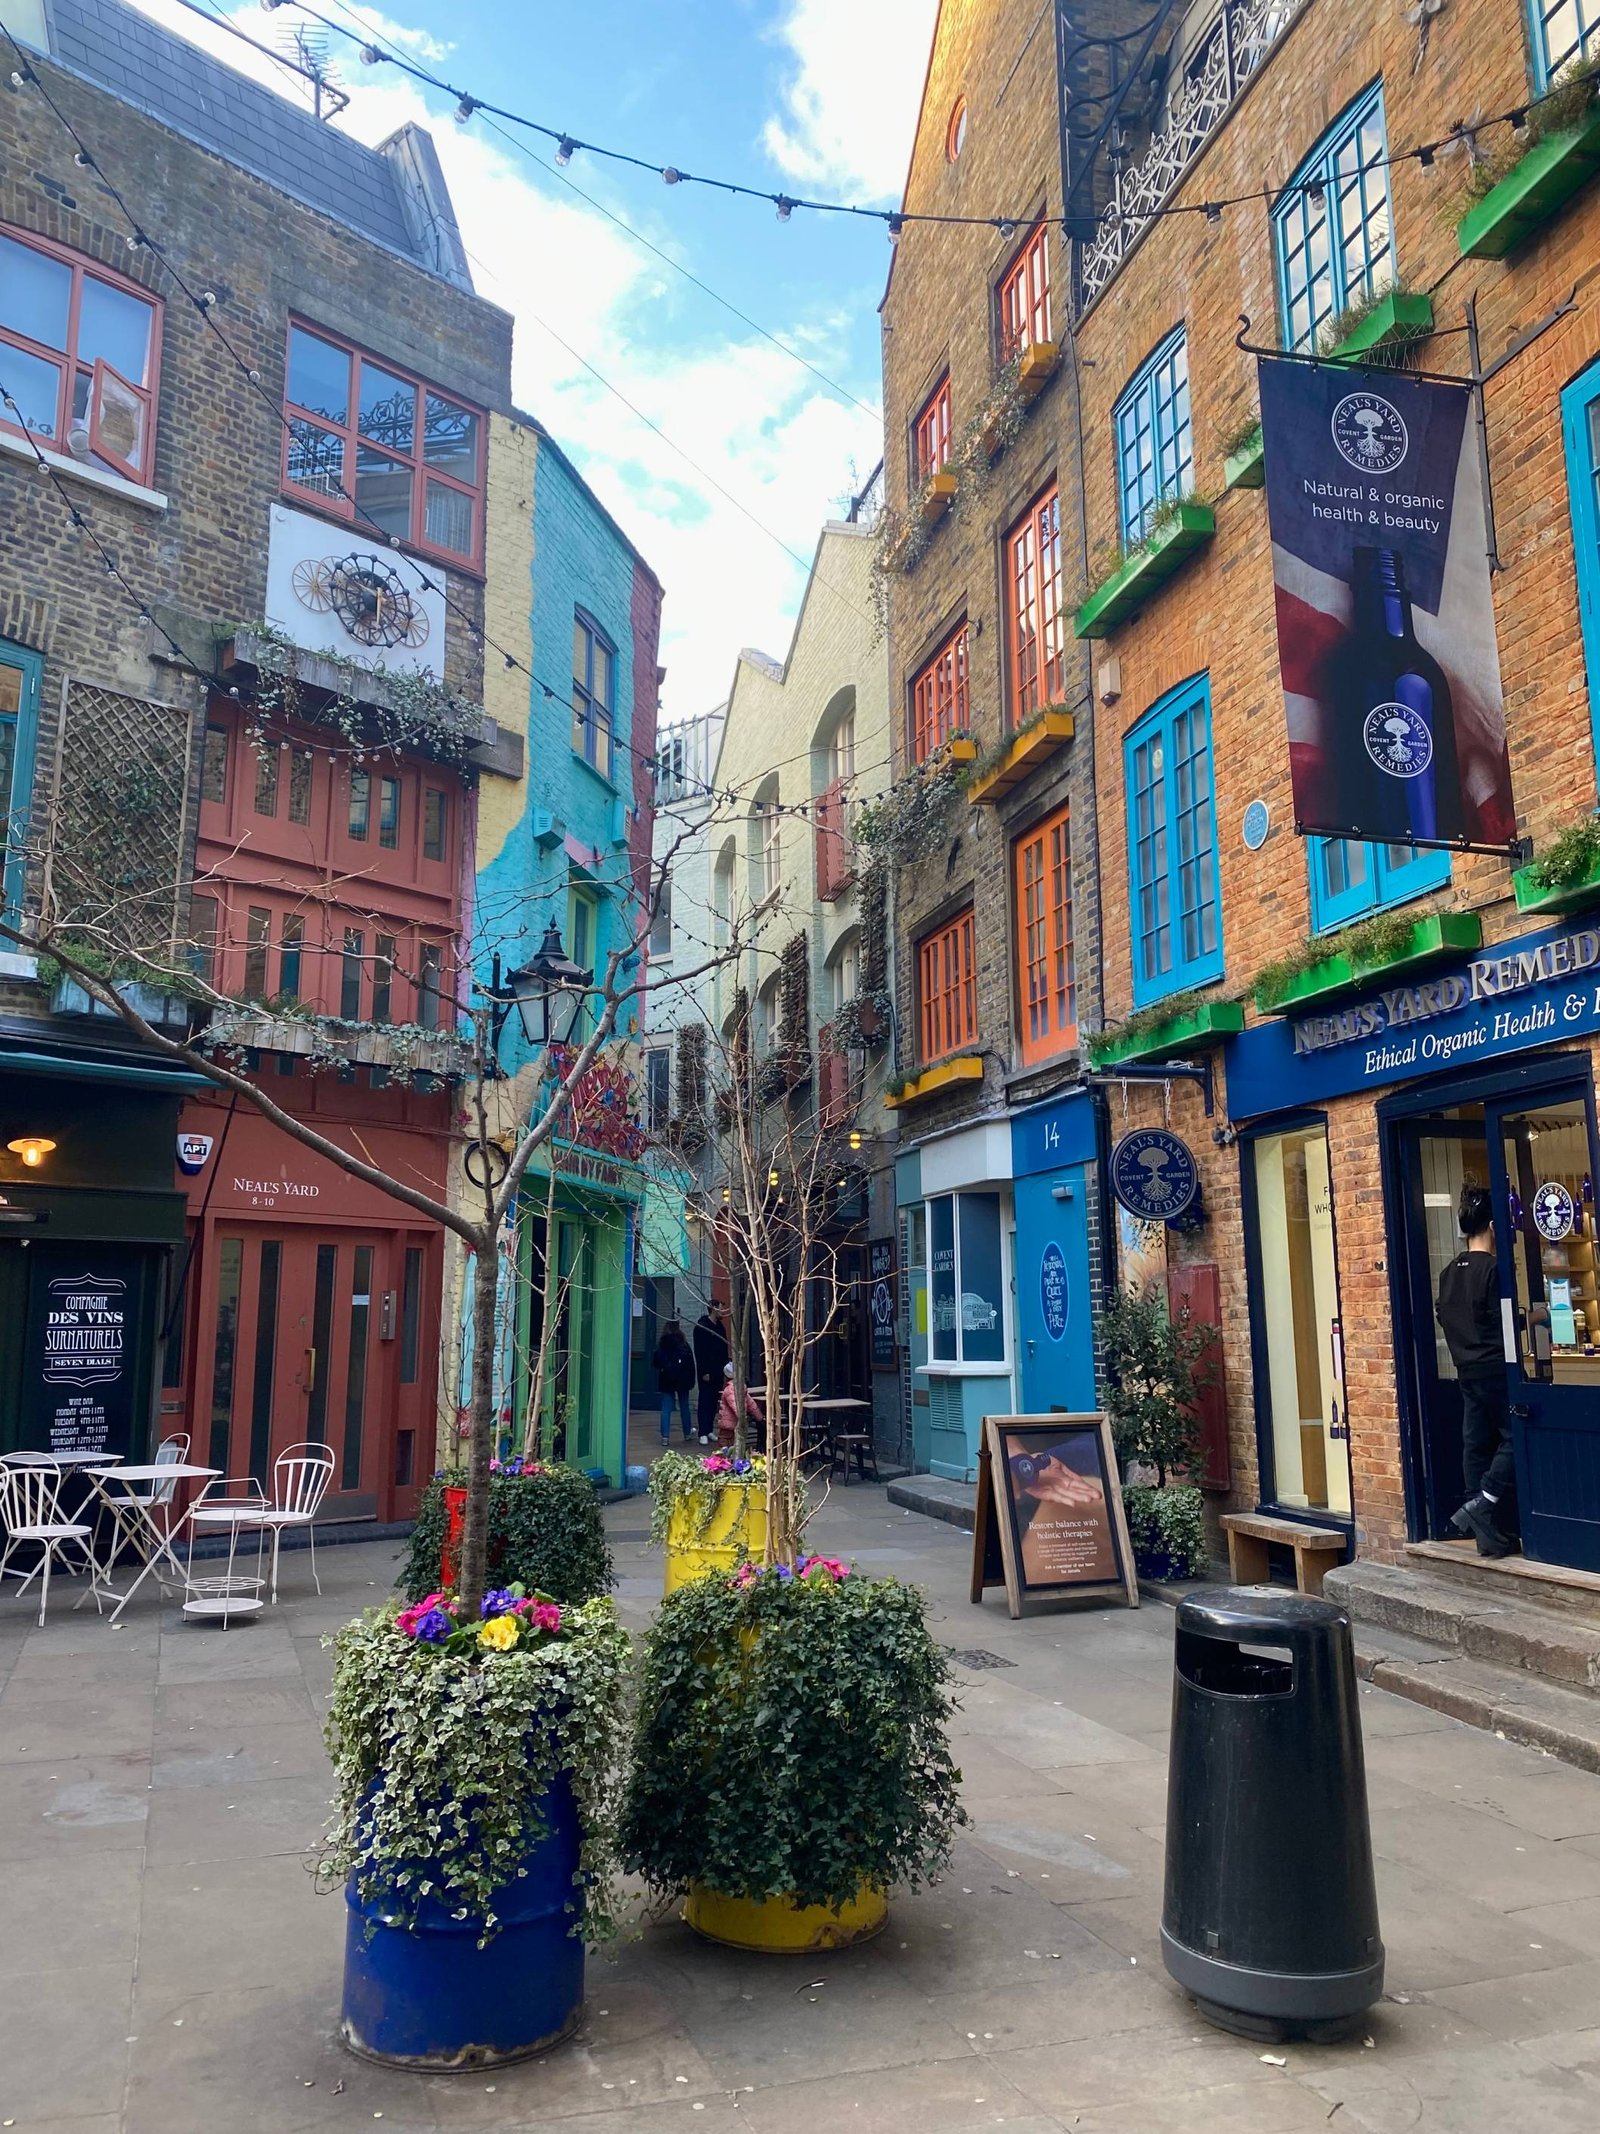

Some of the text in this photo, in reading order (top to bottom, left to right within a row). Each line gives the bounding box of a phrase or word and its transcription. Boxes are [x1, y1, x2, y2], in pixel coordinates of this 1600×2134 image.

[1338, 398, 1401, 433] NEAL'S YARD
[1338, 428, 1402, 442] COVENT GARDEN
[1341, 438, 1401, 468] REMEDIES
[1304, 479, 1445, 510] Natural & organic
[1312, 503, 1440, 534] health & beauty
[1369, 708, 1426, 740] NEAL'S YARD
[1372, 746, 1426, 772] REMEDIES
[1292, 1001, 1382, 1054] NEAL'S
[1380, 976, 1465, 1027] YARD
[1467, 929, 1600, 1001] REMED
[1364, 1039, 1417, 1075] Ethical
[1421, 1020, 1487, 1060] Organic
[1492, 1000, 1556, 1041] Health
[1563, 994, 1587, 1021] &
[1044, 1121, 1060, 1151] 14
[184, 1144, 206, 1154] APT
[1119, 1135, 1188, 1171] NEAL'S YARD
[1166, 1171, 1190, 1179] GARDEN
[233, 1178, 320, 1197] NEAL'S YARD
[1124, 1181, 1190, 1212] REMEDIES
[1538, 1217, 1570, 1236] REMEDIES
[66, 1296, 108, 1310] COMPAGNIE
[48, 1312, 124, 1324] DES VINS
[45, 1330, 122, 1350] SURNATURELS
[54, 1358, 112, 1366] SEVEN DIALS
[56, 1408, 76, 1416] MONDAY
[50, 1427, 80, 1436] WEDNESDAY
[54, 1418, 76, 1426] TUESDAY
[51, 1438, 76, 1446] THURSDAY
[1028, 1518, 1098, 1530] Restore balance with
[1062, 1530, 1093, 1539] therapies
